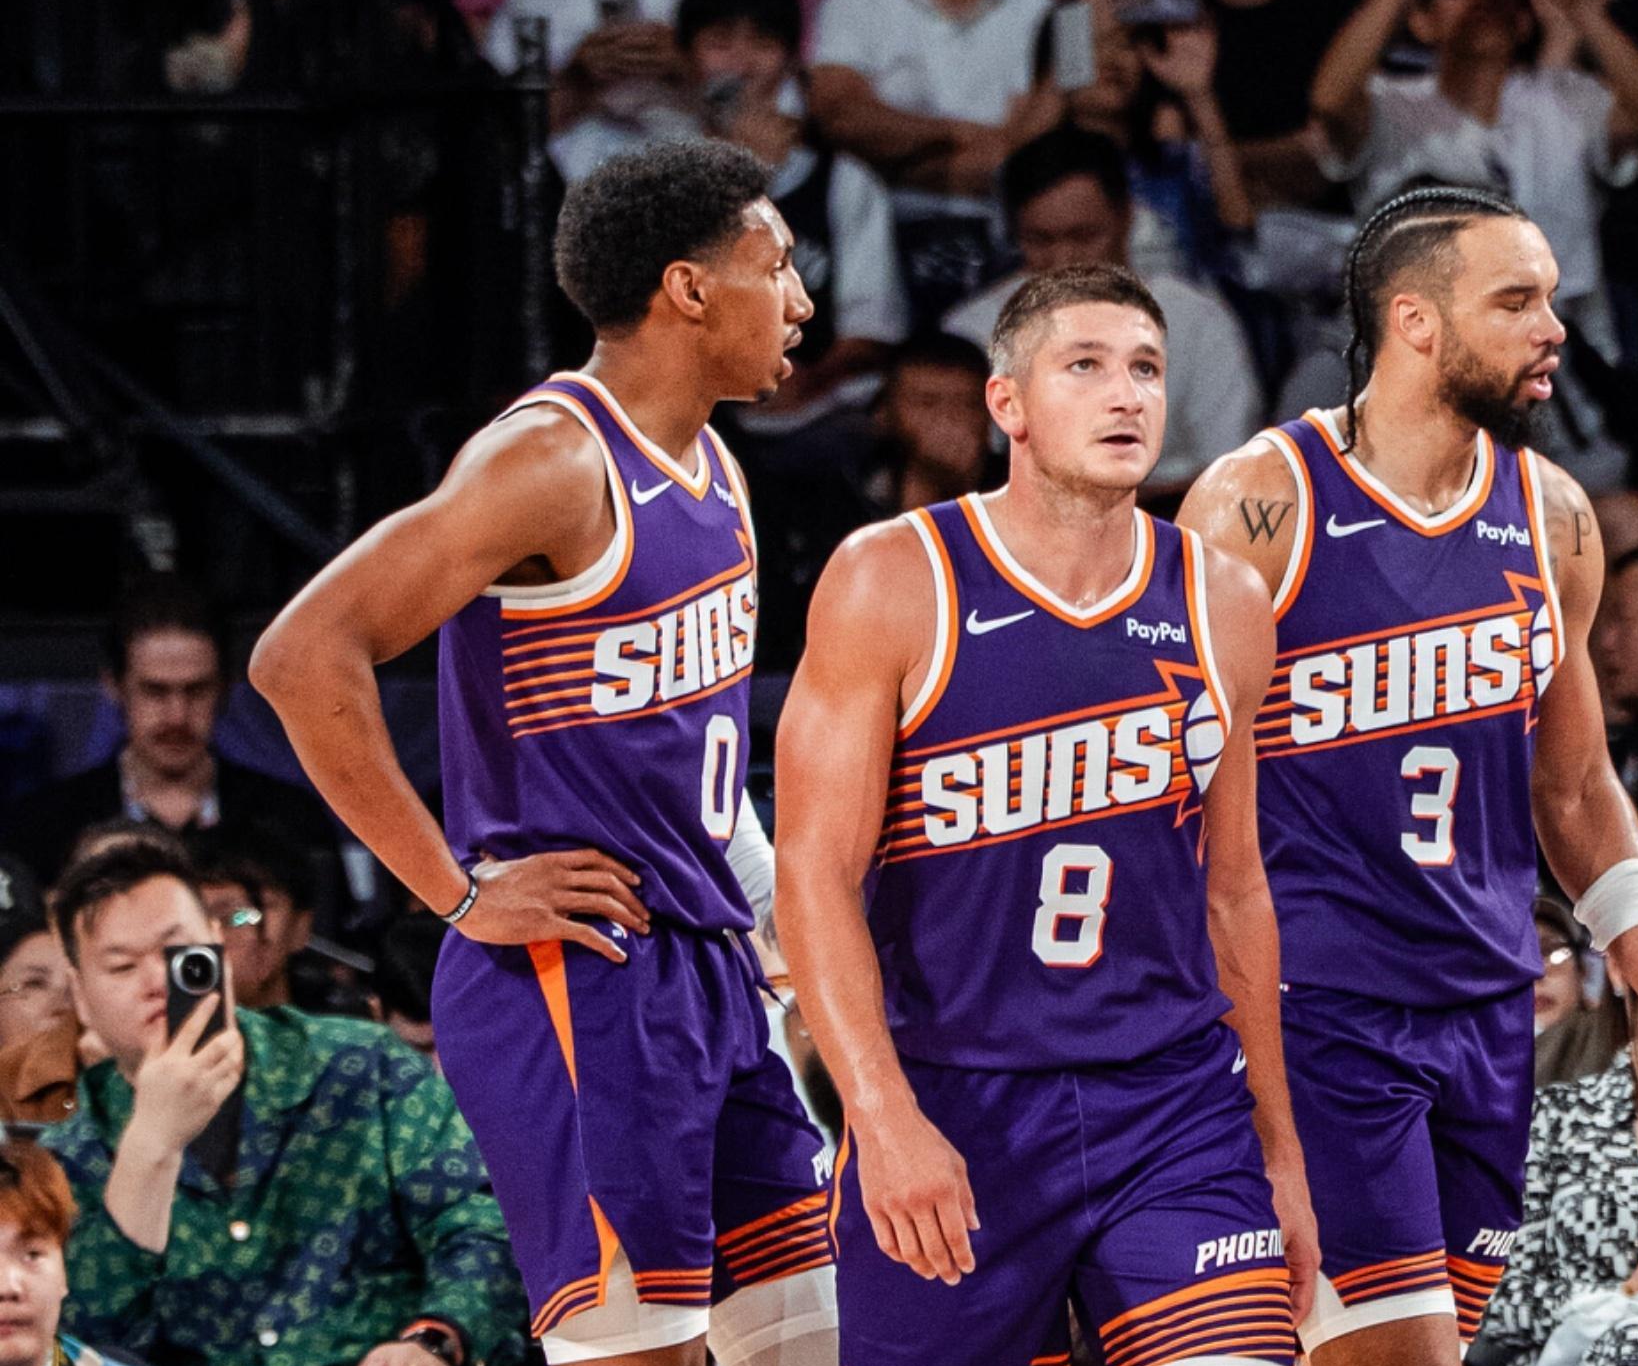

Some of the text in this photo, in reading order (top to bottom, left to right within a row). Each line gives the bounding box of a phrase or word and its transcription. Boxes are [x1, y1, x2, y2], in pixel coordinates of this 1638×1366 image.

[1477, 520, 1531, 546] PayPal
[1126, 618, 1187, 644] PayPal
[1290, 616, 1522, 745] SUNS
[701, 714, 739, 840] 0
[921, 707, 1173, 847] SUNS
[1400, 745, 1460, 867] 3
[1031, 843, 1114, 968] 8
